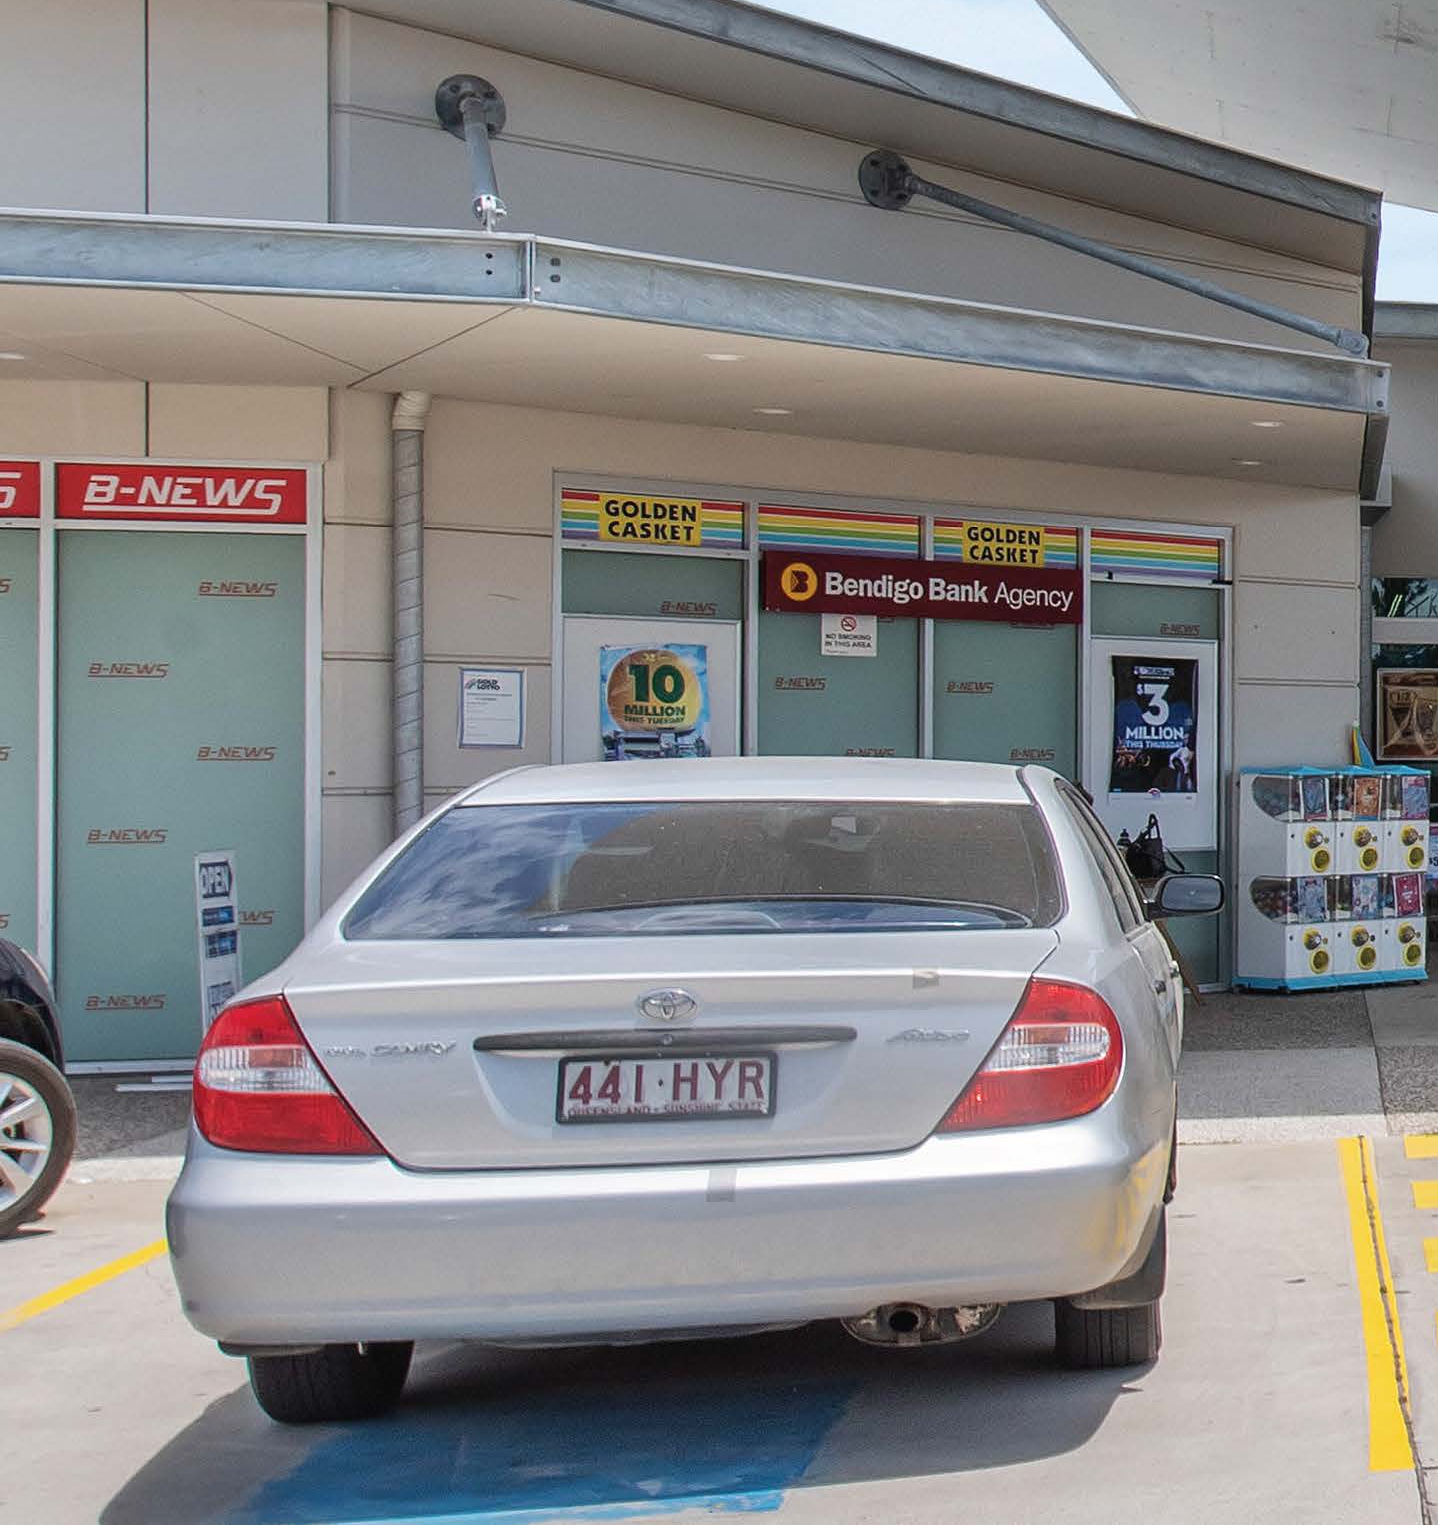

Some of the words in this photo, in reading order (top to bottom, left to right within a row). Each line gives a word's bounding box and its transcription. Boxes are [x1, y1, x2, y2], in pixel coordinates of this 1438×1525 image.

[82, 474, 287, 515] B-NEWS
[604, 499, 697, 522] GOLDEN
[608, 521, 694, 542] CASKET
[967, 526, 1041, 546] GOLDEN
[969, 545, 1039, 564] CASKET
[198, 581, 278, 597] B-NEWS
[825, 572, 924, 604] Bendigo
[929, 577, 988, 604] Bank
[994, 582, 1074, 612] Agency
[88, 662, 170, 678] B-NEWS
[628, 664, 686, 704] 10
[624, 705, 686, 716] MILLION
[1125, 726, 1185, 740] MILLION
[196, 746, 277, 761] B-NEWS
[87, 828, 168, 844] B-NEWS
[85, 994, 166, 1010] B-NEWS
